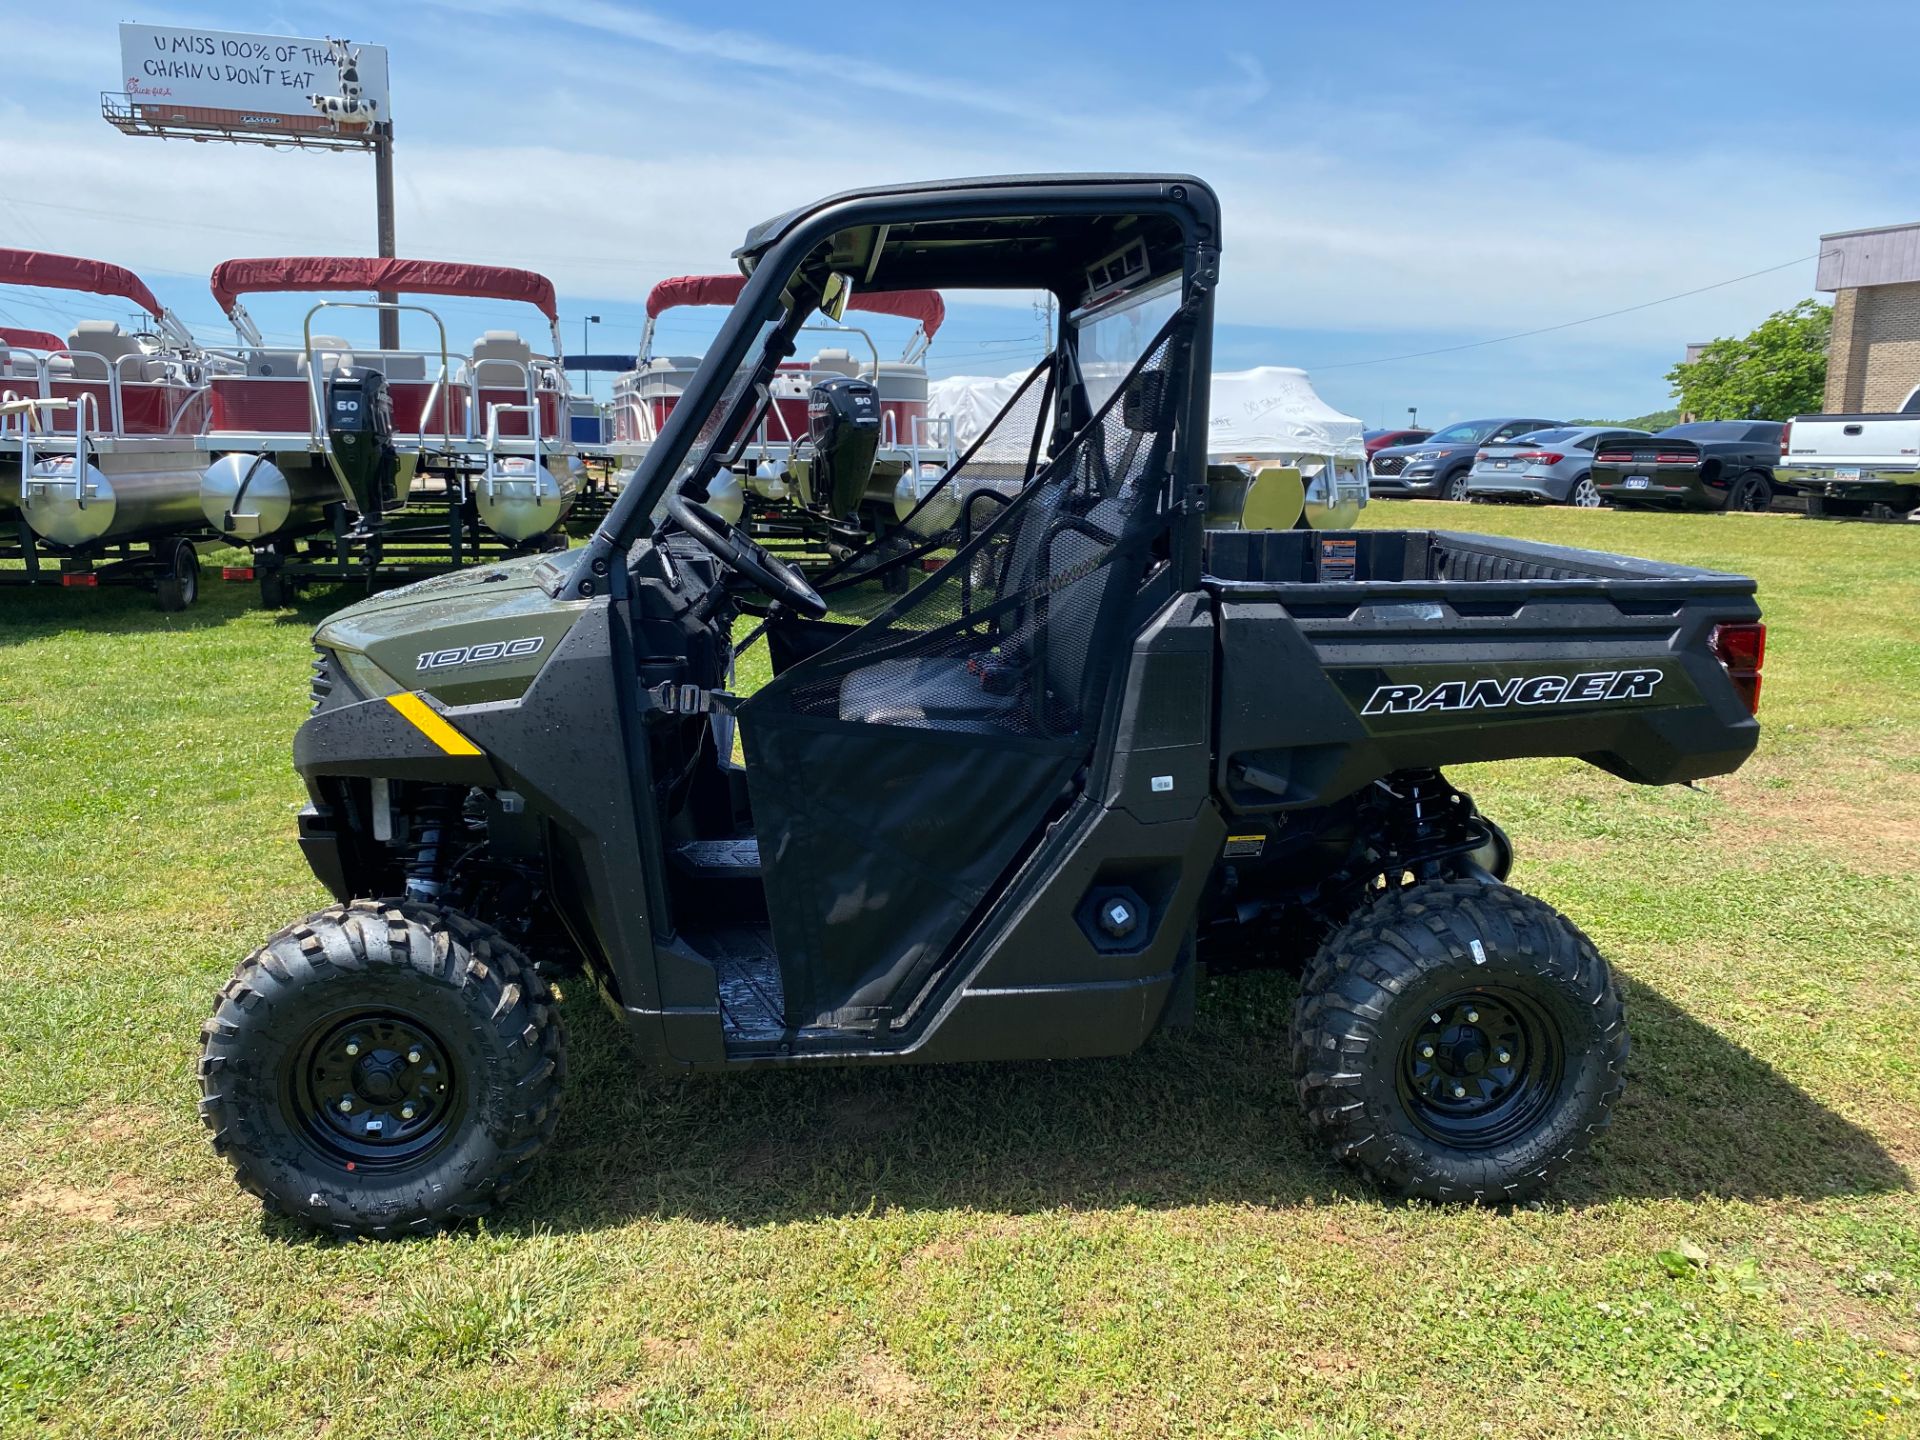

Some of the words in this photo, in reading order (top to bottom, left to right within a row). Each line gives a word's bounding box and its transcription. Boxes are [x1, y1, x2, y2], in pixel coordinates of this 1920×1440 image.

[154, 35, 166, 51] U
[172, 35, 215, 55] MISS
[221, 40, 270, 61] 100%
[275, 45, 298, 62] OF
[143, 59, 203, 79] CHIKIN
[207, 66, 220, 81] U
[225, 64, 276, 85] DON'T
[280, 69, 315, 90] EAT
[336, 401, 358, 411] 60
[854, 397, 871, 406] 90
[416, 636, 544, 671] 1000
[1360, 669, 1664, 715] RANGER
